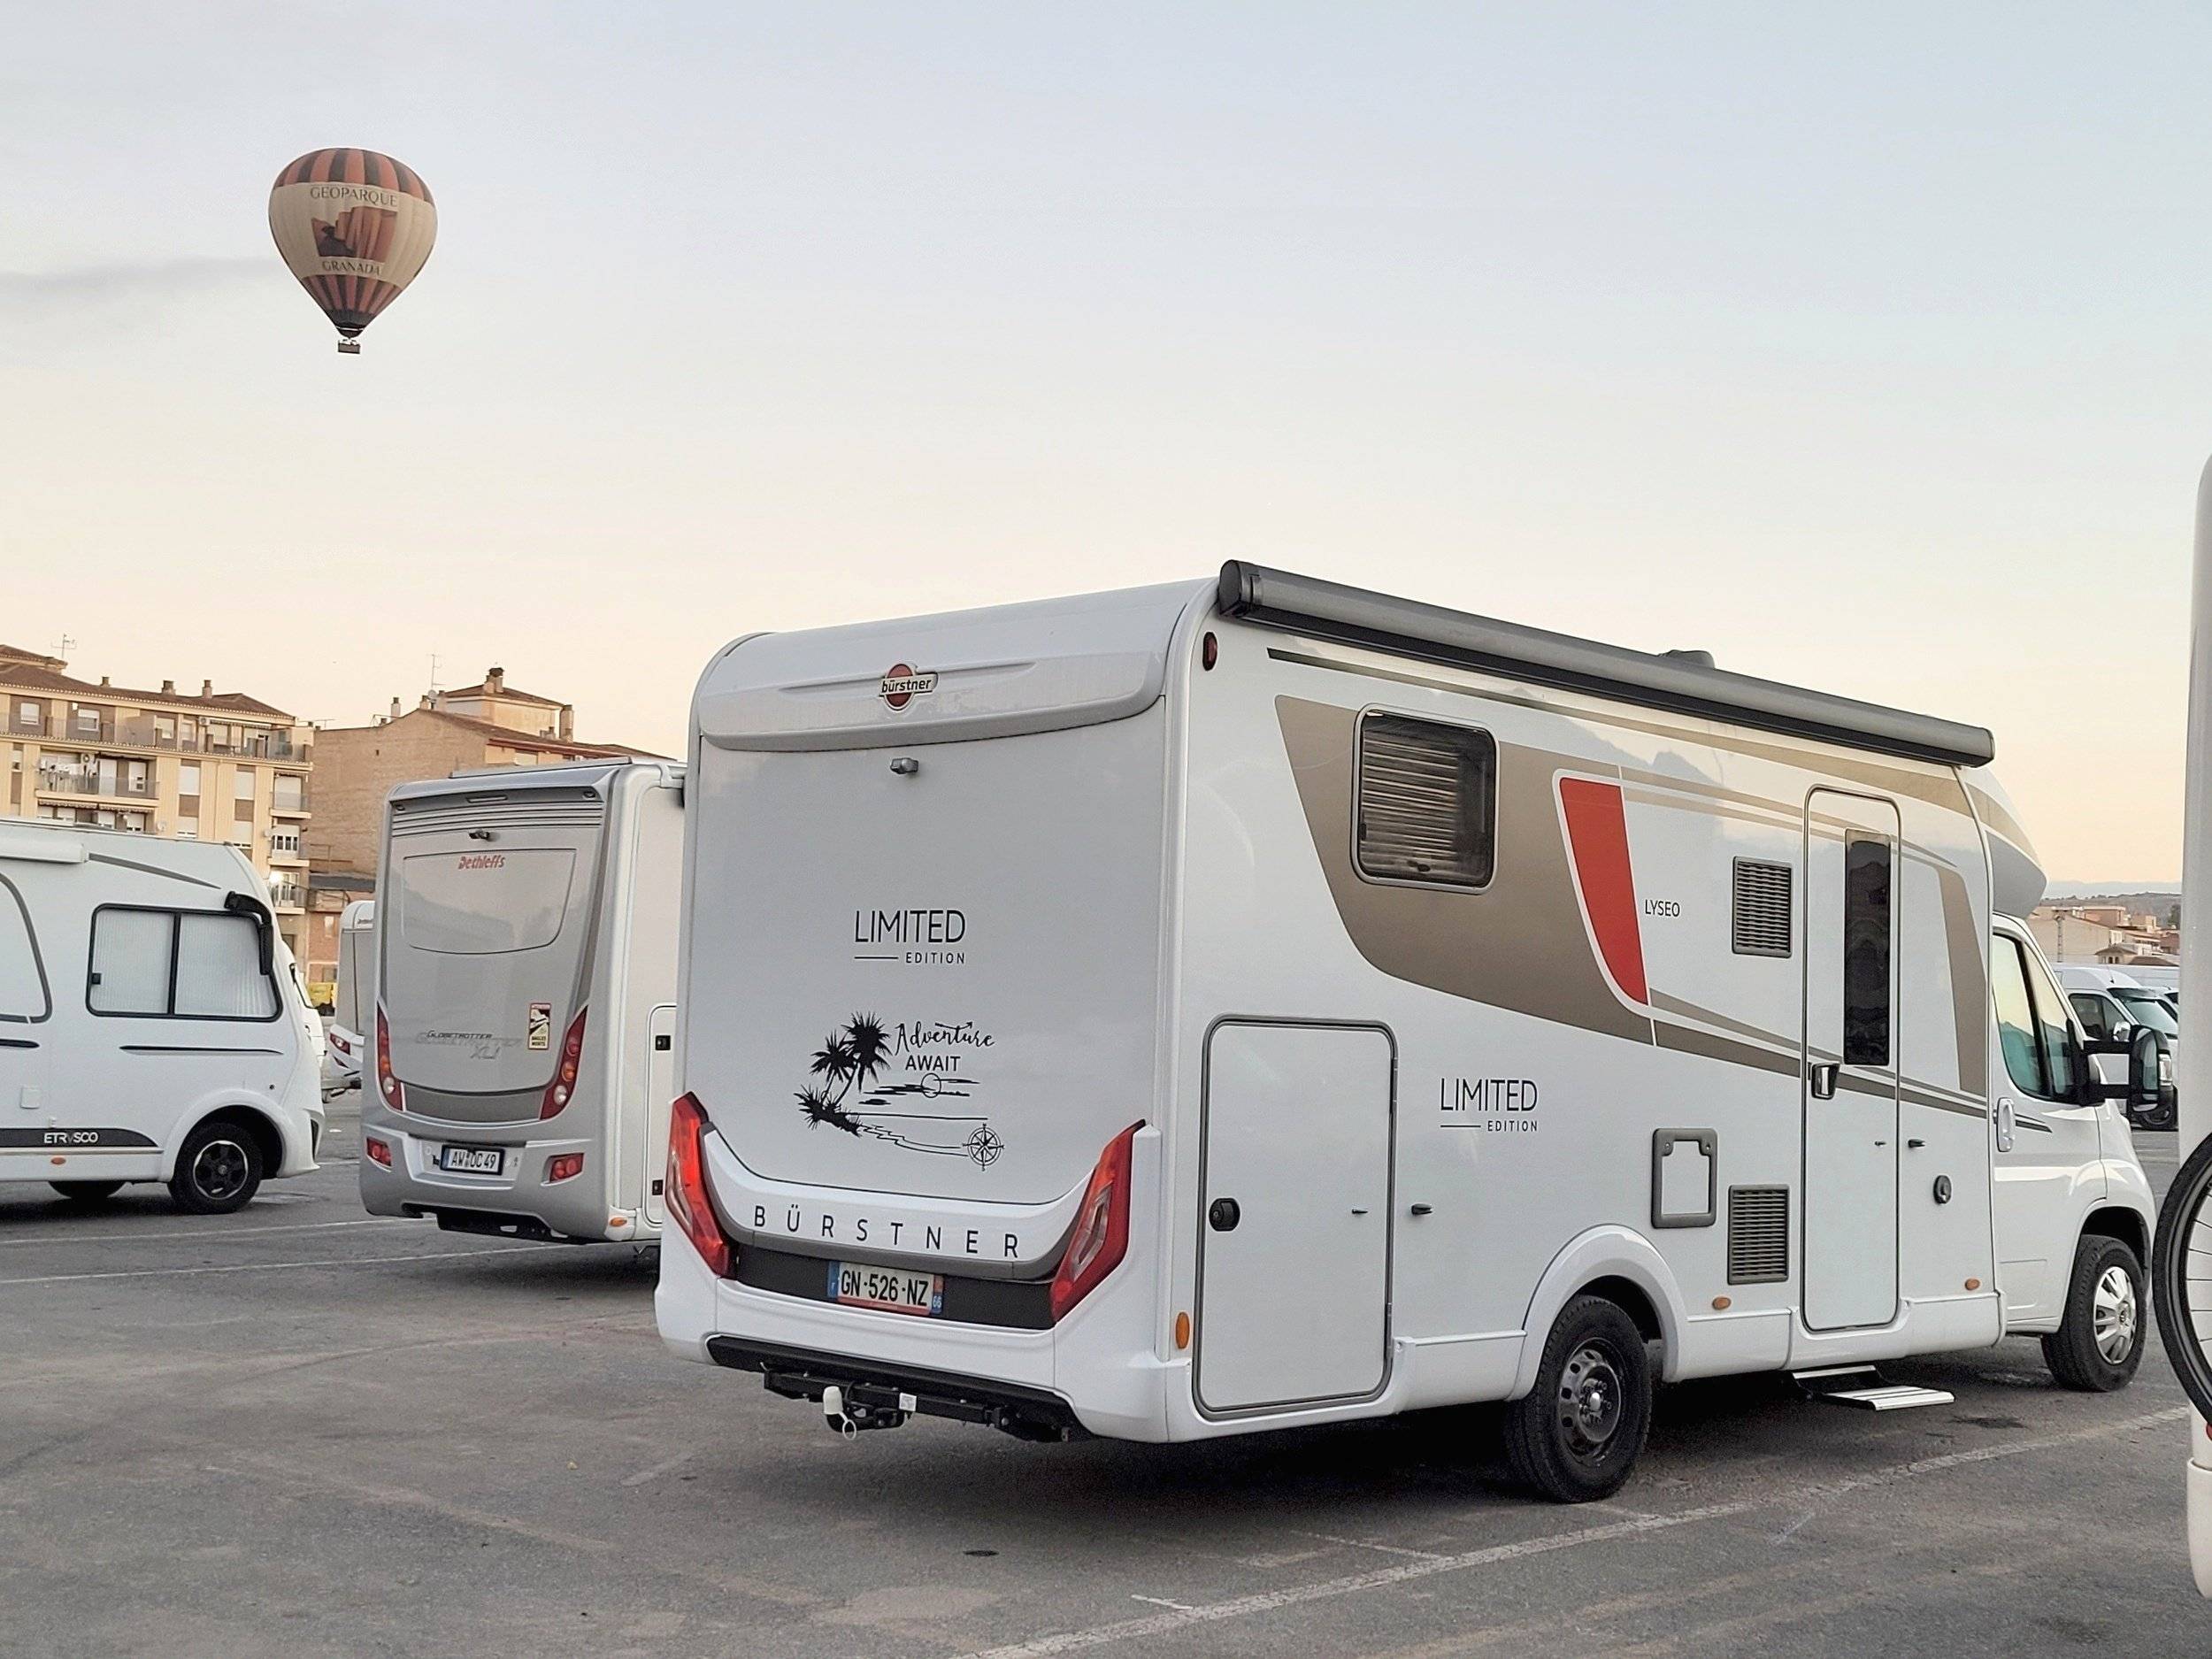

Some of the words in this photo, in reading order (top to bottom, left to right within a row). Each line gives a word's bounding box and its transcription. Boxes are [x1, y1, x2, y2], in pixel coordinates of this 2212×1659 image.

[310, 186, 397, 207] GEOPARQUE
[321, 261, 381, 276] GRANADA
[881, 680, 932, 693] bürstner
[458, 855, 505, 869] Dethleffs
[1645, 899, 1680, 917] LYSEO
[855, 910, 966, 943] LIMITED
[905, 951, 965, 964] EDITION
[895, 1020, 995, 1056] Adventure
[905, 1055, 961, 1071] AWAIT
[1440, 1078, 1538, 1111] LIMITED
[1487, 1120, 1538, 1132] EDITION
[484, 1153, 496, 1169] 49
[753, 1204, 1018, 1258] BÜRSTNER
[933, 1294, 942, 1309] 66
